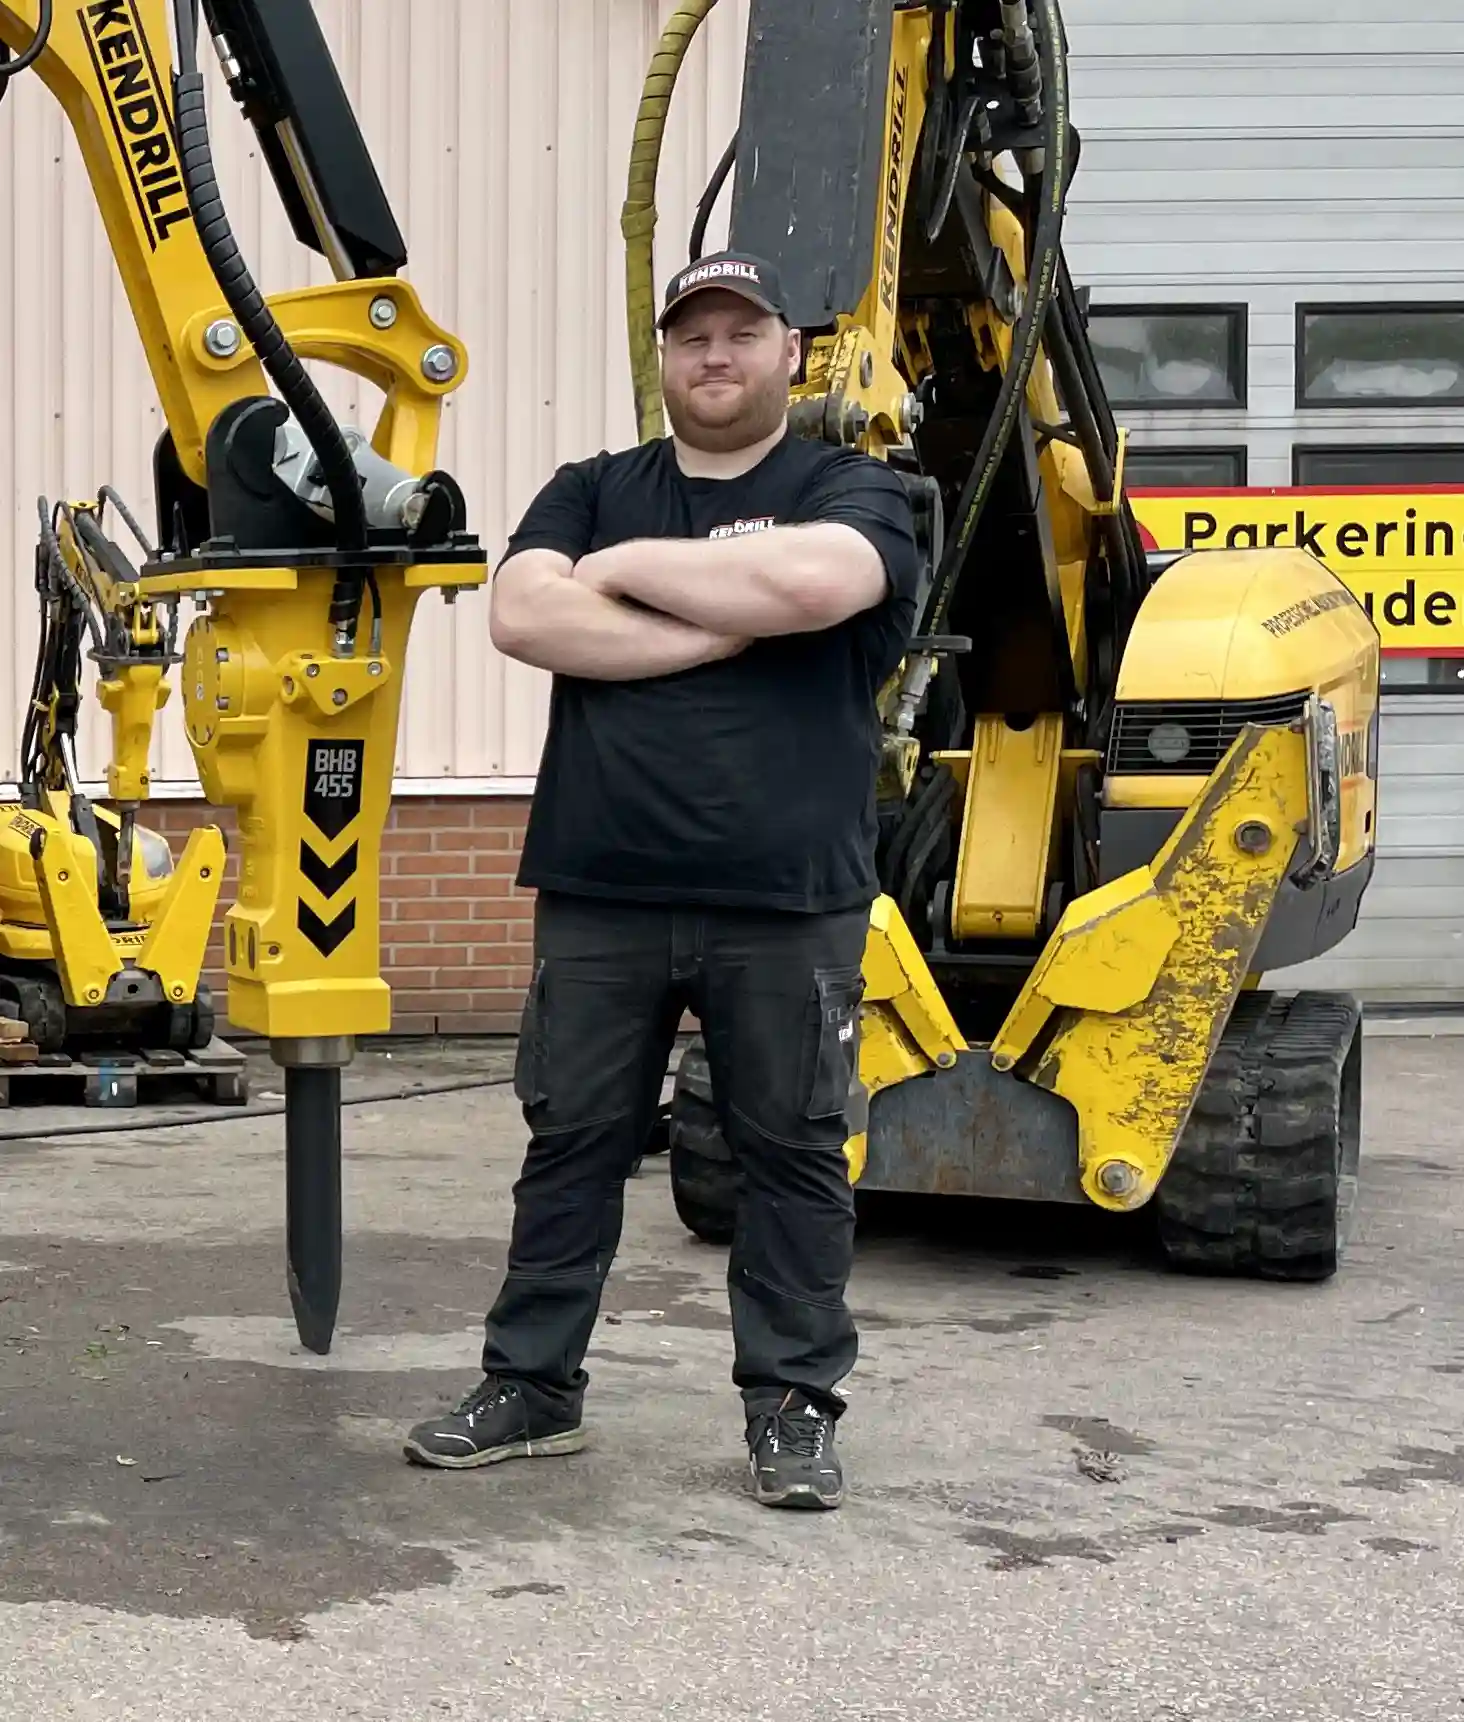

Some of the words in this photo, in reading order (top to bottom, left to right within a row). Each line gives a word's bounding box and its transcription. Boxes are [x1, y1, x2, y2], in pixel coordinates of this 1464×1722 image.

[87, 0, 193, 241] KENDRILL
[880, 67, 906, 314] KENDRILL
[1185, 507, 1464, 557] Parkerin
[313, 773, 354, 798] 455
[314, 748, 357, 773] BHB
